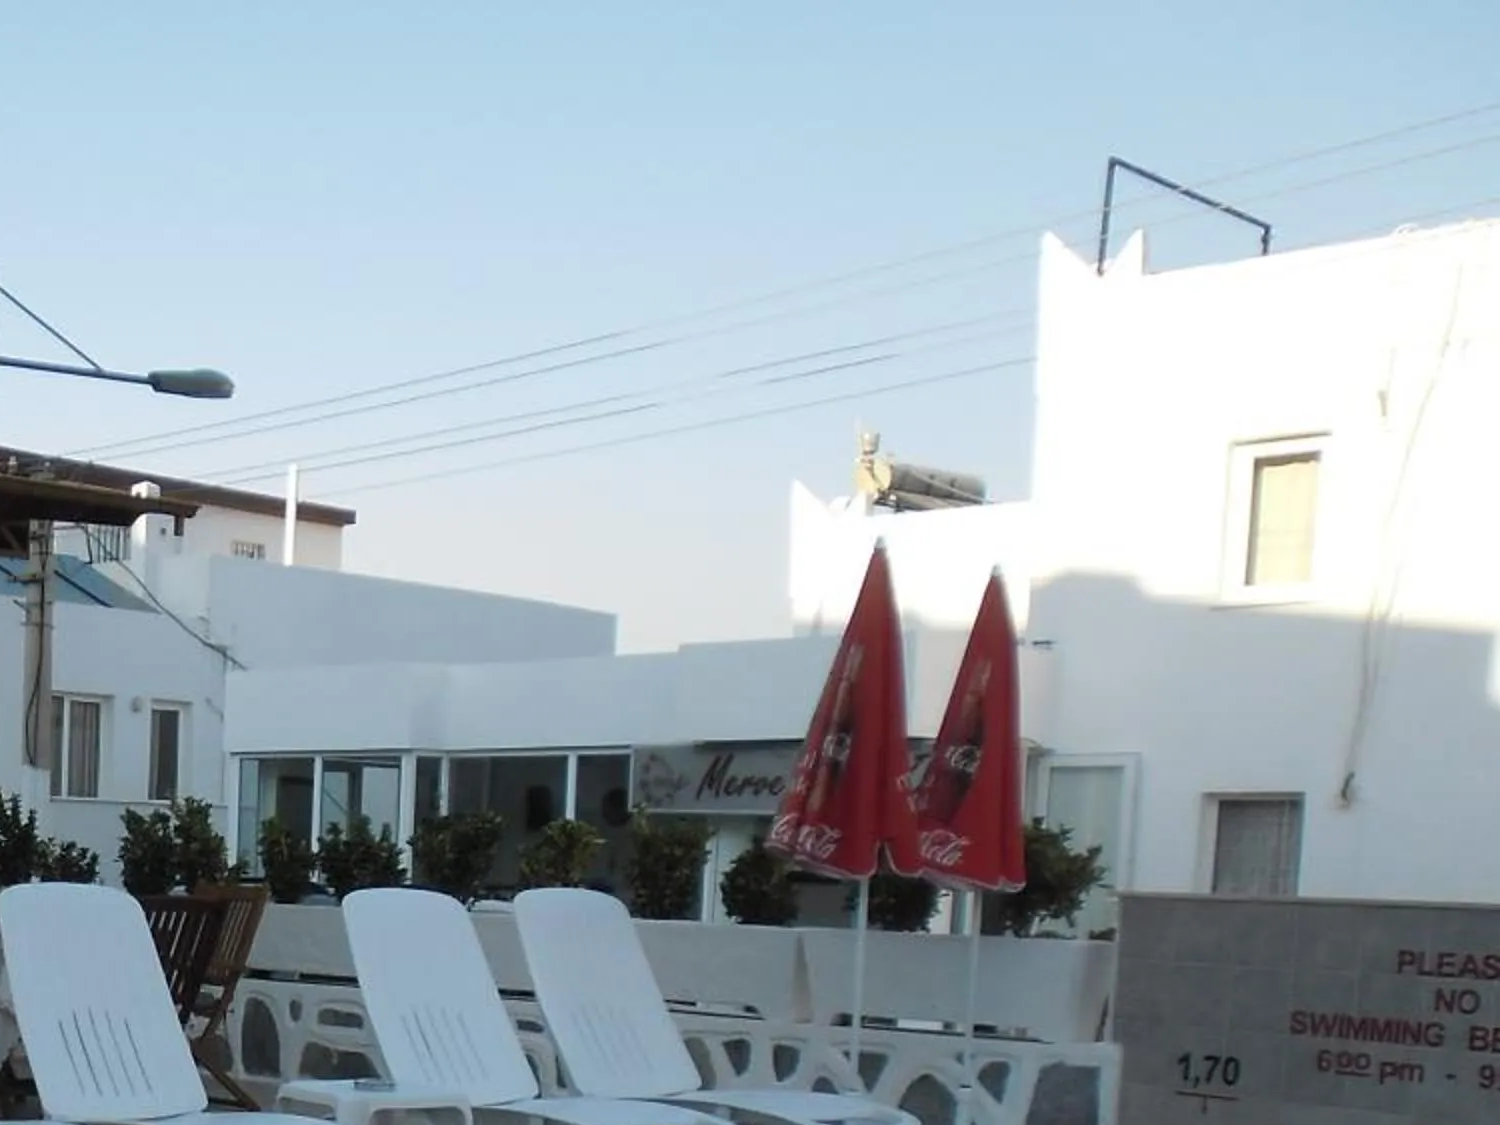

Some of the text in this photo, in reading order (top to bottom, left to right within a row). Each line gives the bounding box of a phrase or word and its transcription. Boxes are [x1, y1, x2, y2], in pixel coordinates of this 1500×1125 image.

[1434, 987, 1482, 1015] NO
[1289, 1010, 1446, 1048] SWIMMING
[1176, 1052, 1241, 1088] 1,70
[1379, 1061, 1425, 1085] pm
[1478, 1063, 1500, 1090] 9
